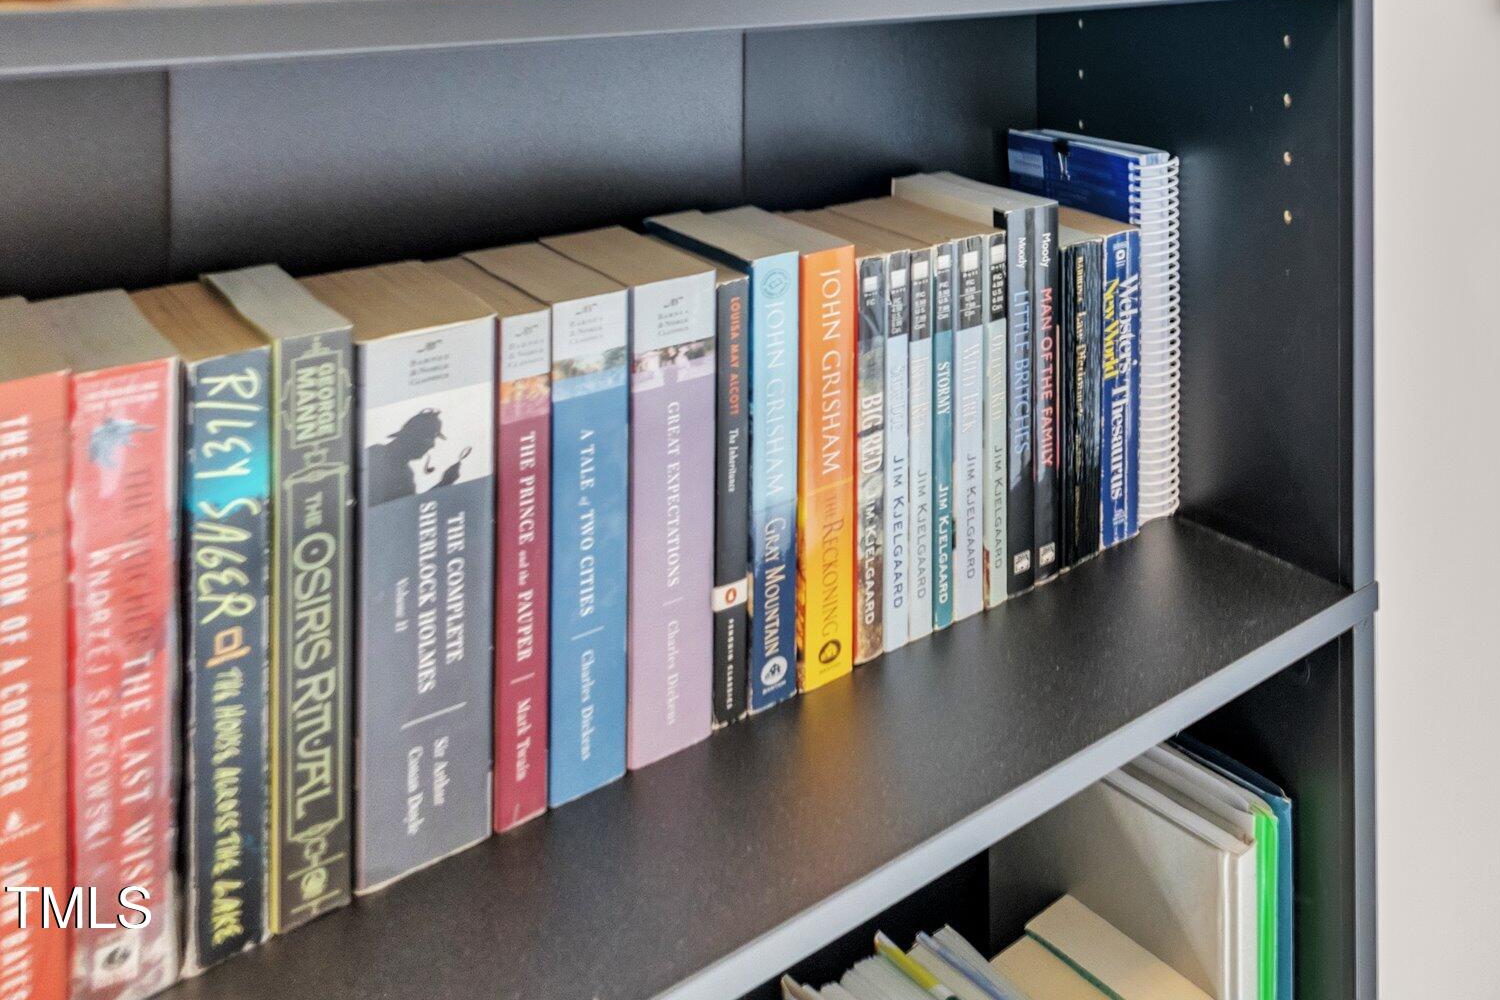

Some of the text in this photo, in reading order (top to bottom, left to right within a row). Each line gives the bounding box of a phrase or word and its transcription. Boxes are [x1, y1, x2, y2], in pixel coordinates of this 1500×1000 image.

[1015, 237, 1028, 269] Moody
[1039, 232, 1053, 268] Moody
[728, 296, 741, 416] LOUISA MAY ALCOTT
[819, 268, 843, 476] JOHN GRISHAM
[1013, 290, 1030, 454] LITTLE BRITCHES
[1039, 287, 1054, 468] MAN OF THE FAMILY
[1102, 276, 1121, 380] New World
[1116, 273, 1139, 373] Webster's
[295, 366, 318, 441] MANN
[316, 363, 336, 436] GEORGE
[764, 299, 787, 496] JOHN GRISHAM
[860, 394, 883, 475] BIG RED
[936, 361, 951, 416] STORMY
[1110, 379, 1130, 501] Thesaurus
[193, 367, 264, 627] RILEY SAGER
[516, 431, 536, 663] THE PRINCE PAUPER
[578, 429, 596, 618] A TALE TWO CITIES
[665, 401, 682, 588] GREAT EXPECTATIONS
[891, 454, 906, 610] JIM KJELGAARD
[916, 469, 929, 600] JIM KJELGAARD
[938, 483, 951, 605] JIM KJELGAARD
[965, 453, 978, 579] JIM KJELGAARD
[417, 501, 437, 695] SHERLOCK HOLMES
[446, 512, 465, 664] THE COMPLETE
[763, 517, 787, 657] GRAY MOUNTAIN
[820, 518, 845, 637] RECKONING
[119, 652, 154, 806] THE LAST
[292, 533, 339, 818] OSIRIS RITUAL
[578, 649, 596, 761] Charles Dickens
[211, 880, 246, 945] LAKE
